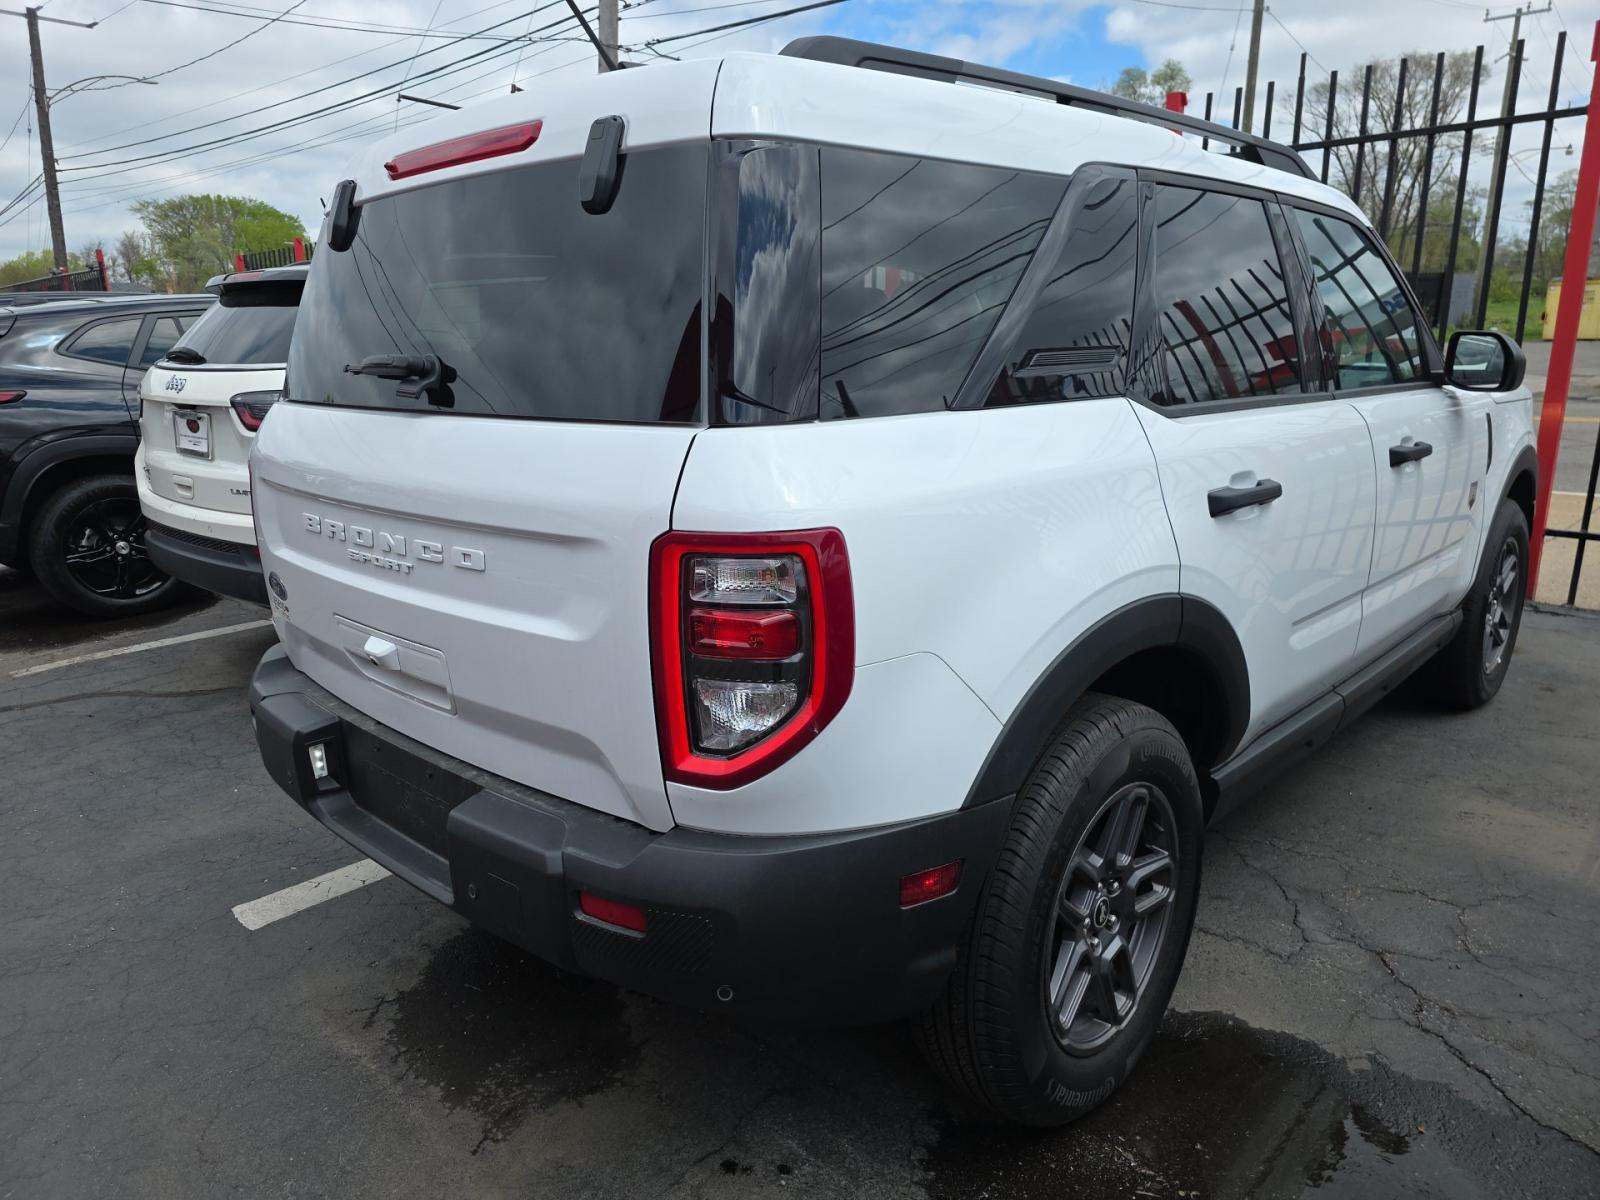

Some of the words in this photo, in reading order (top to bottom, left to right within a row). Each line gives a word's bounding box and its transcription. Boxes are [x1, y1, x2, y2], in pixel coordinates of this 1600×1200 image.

[166, 374, 187, 395] Jeep
[302, 512, 486, 573] BRONCO
[346, 548, 416, 576] SPORT
